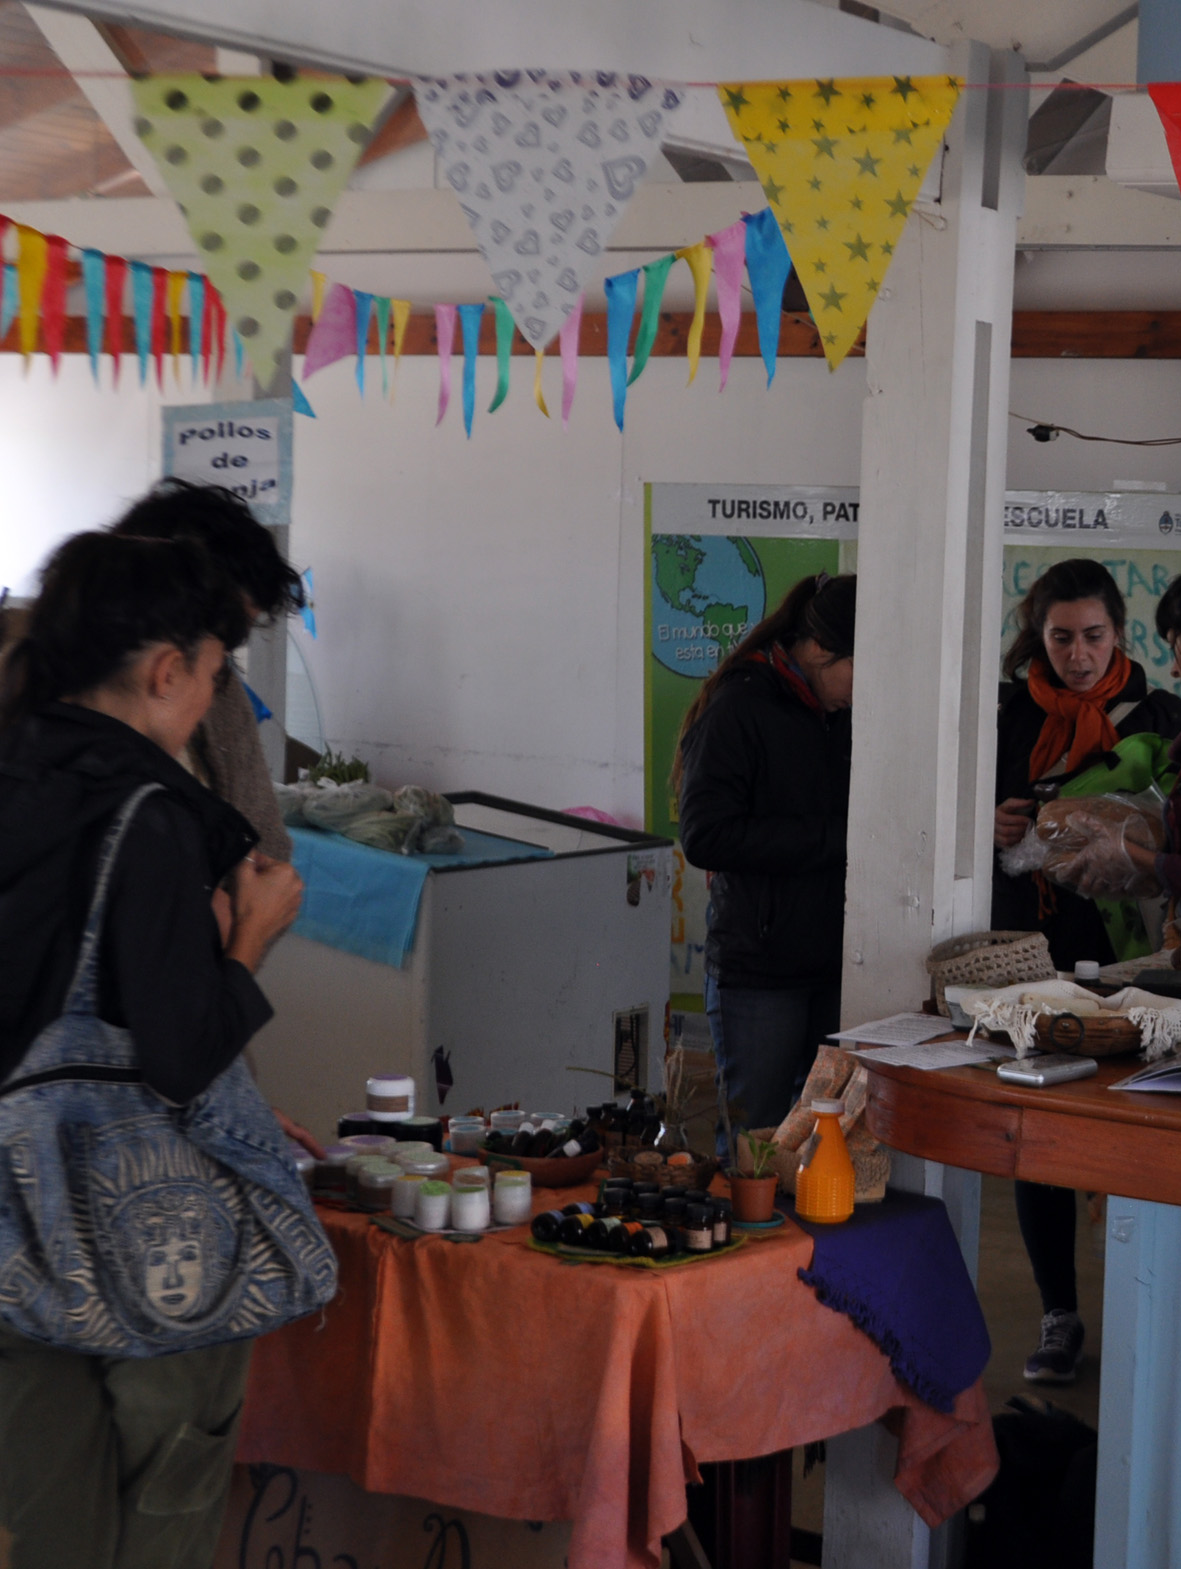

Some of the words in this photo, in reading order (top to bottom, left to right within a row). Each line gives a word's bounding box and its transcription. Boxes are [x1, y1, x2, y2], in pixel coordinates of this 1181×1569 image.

[179, 421, 272, 445] Pollos
[211, 452, 248, 469] de
[708, 499, 814, 524] TURISMO,
[658, 624, 669, 640] El
[672, 620, 720, 639] mundo
[721, 622, 748, 639] que
[676, 643, 705, 660] esta
[706, 644, 725, 658] en
